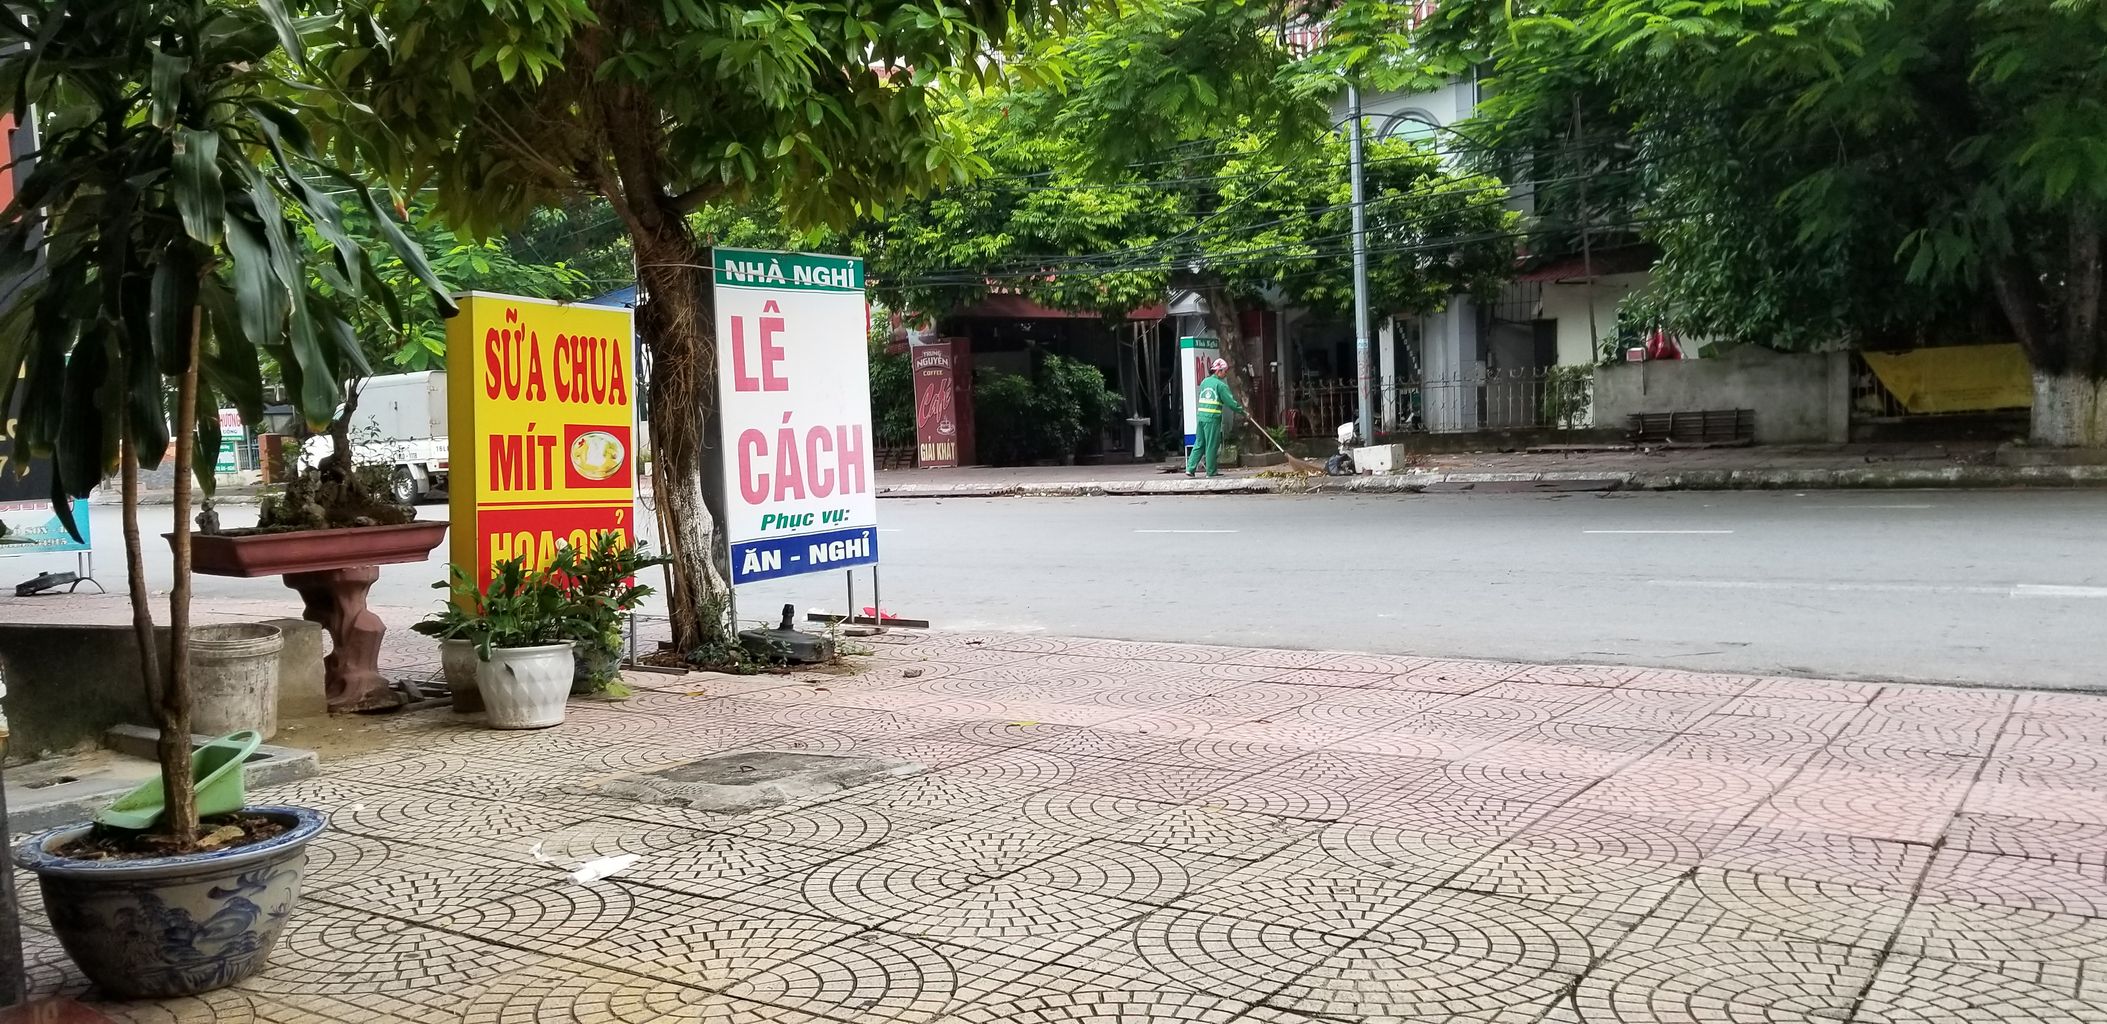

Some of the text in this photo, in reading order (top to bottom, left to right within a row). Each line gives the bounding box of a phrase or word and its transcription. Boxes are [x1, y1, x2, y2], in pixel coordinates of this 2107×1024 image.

[725, 258, 855, 289] NHÀ NGHỈ
[485, 307, 627, 406] SỮA CHUA
[730, 300, 789, 392] LÊ
[489, 422, 557, 491] MÍT
[737, 411, 866, 505] CÁCH
[741, 530, 871, 575] ĂN - NGHỈ
[760, 508, 850, 532] Phục vụ:
